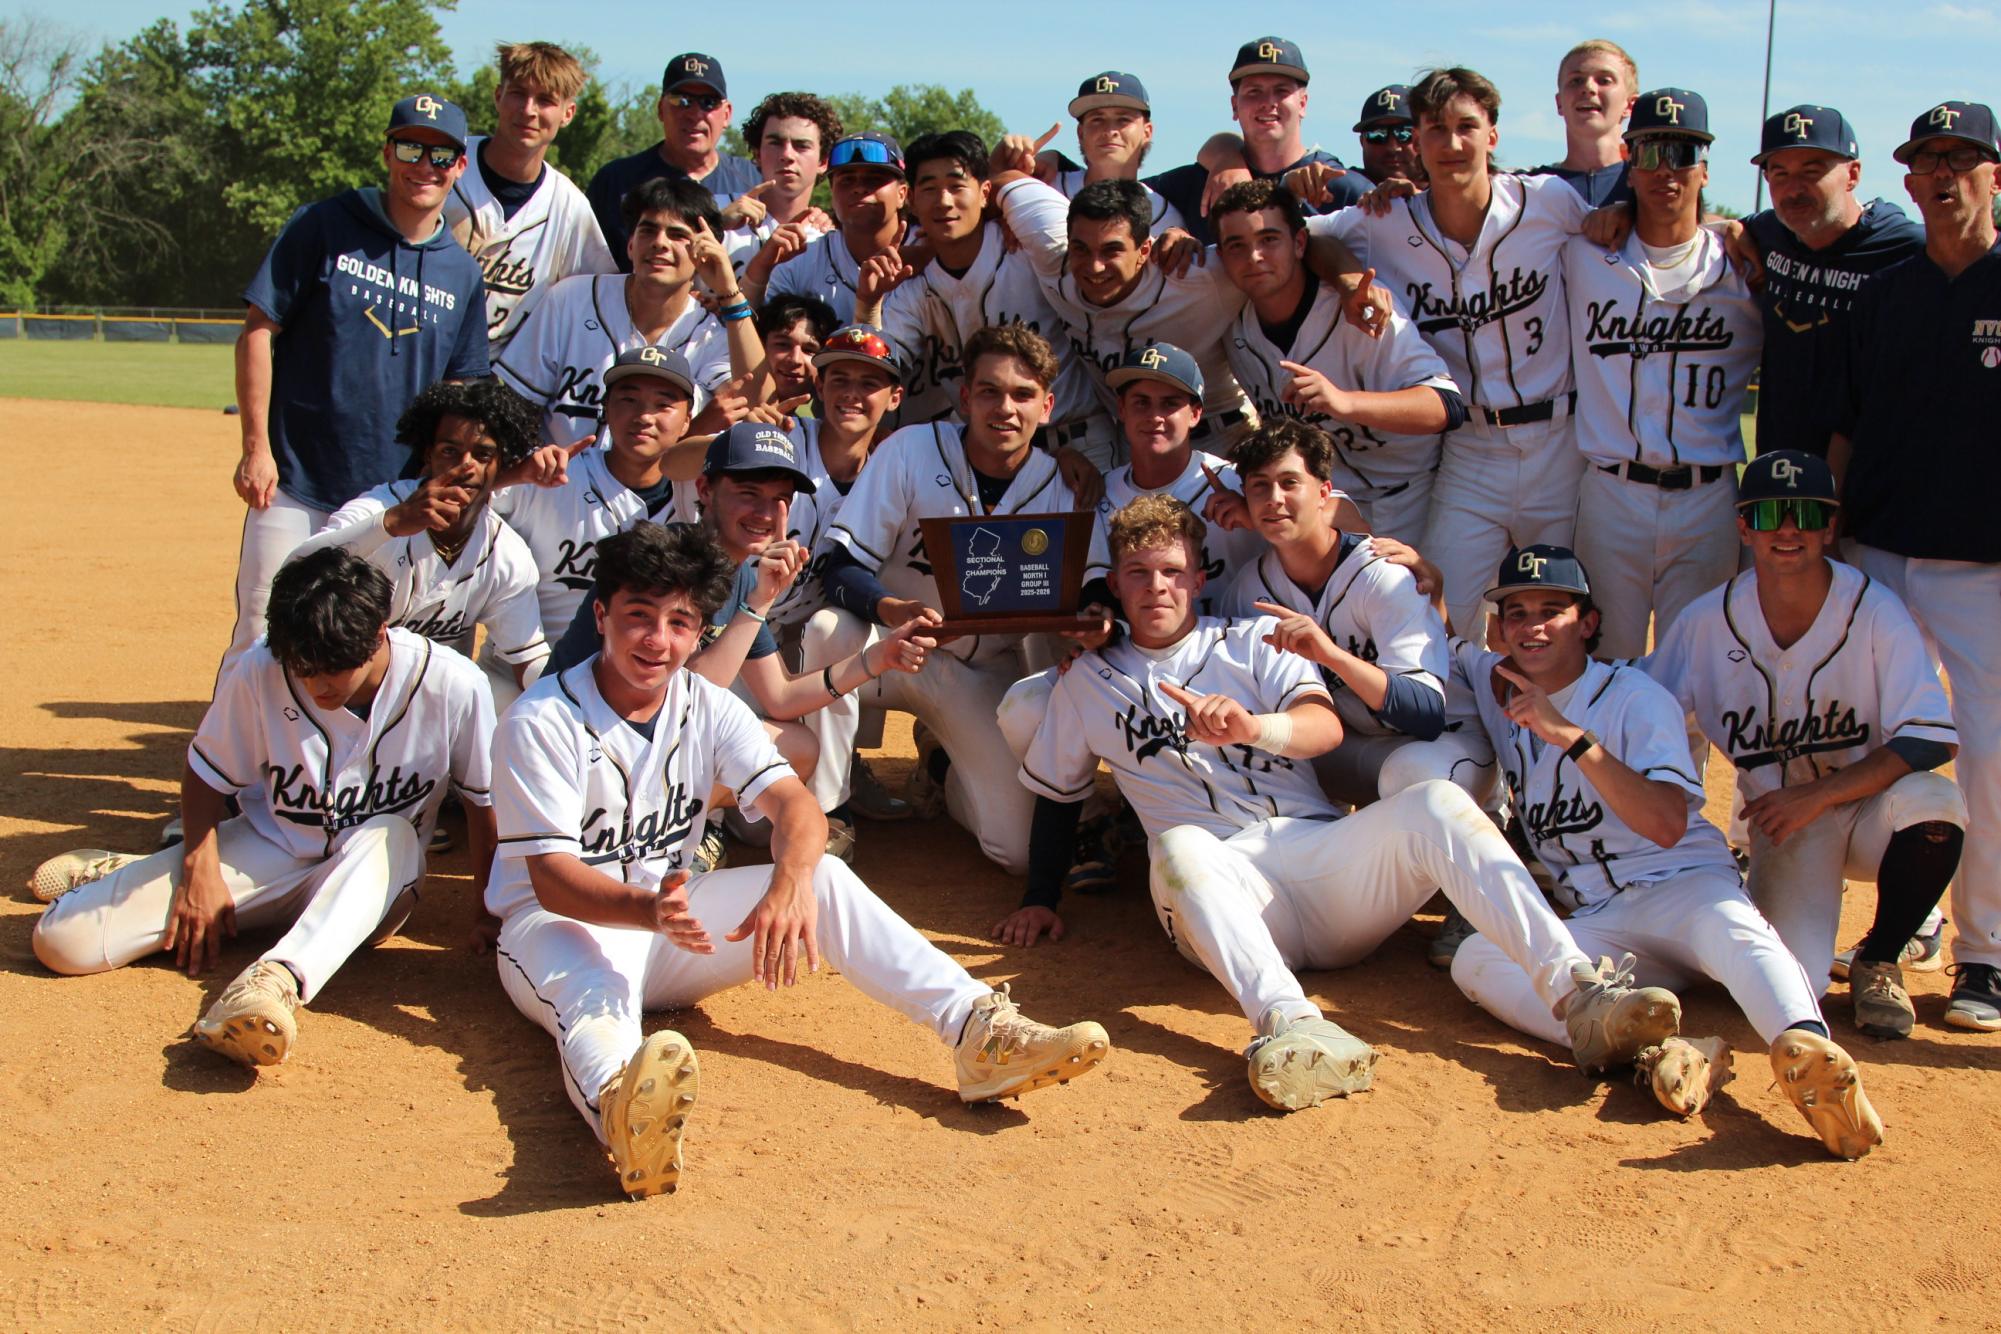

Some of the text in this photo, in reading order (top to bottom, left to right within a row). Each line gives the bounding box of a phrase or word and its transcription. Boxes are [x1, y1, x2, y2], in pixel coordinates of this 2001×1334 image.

[336, 254, 456, 311] GOLDEN KNGHTS
[350, 285, 438, 324] BASEBALL
[1404, 267, 1547, 336] Knights
[1521, 316, 1543, 356] 3
[1587, 299, 1734, 357] Knights
[1684, 363, 1725, 409] 10
[965, 568, 1007, 577] CHAMPIONS
[966, 556, 1005, 564] SECTIONAL
[1021, 580, 1042, 588] GROUP
[1722, 699, 1870, 767] Knights
[269, 763, 436, 828] Knights
